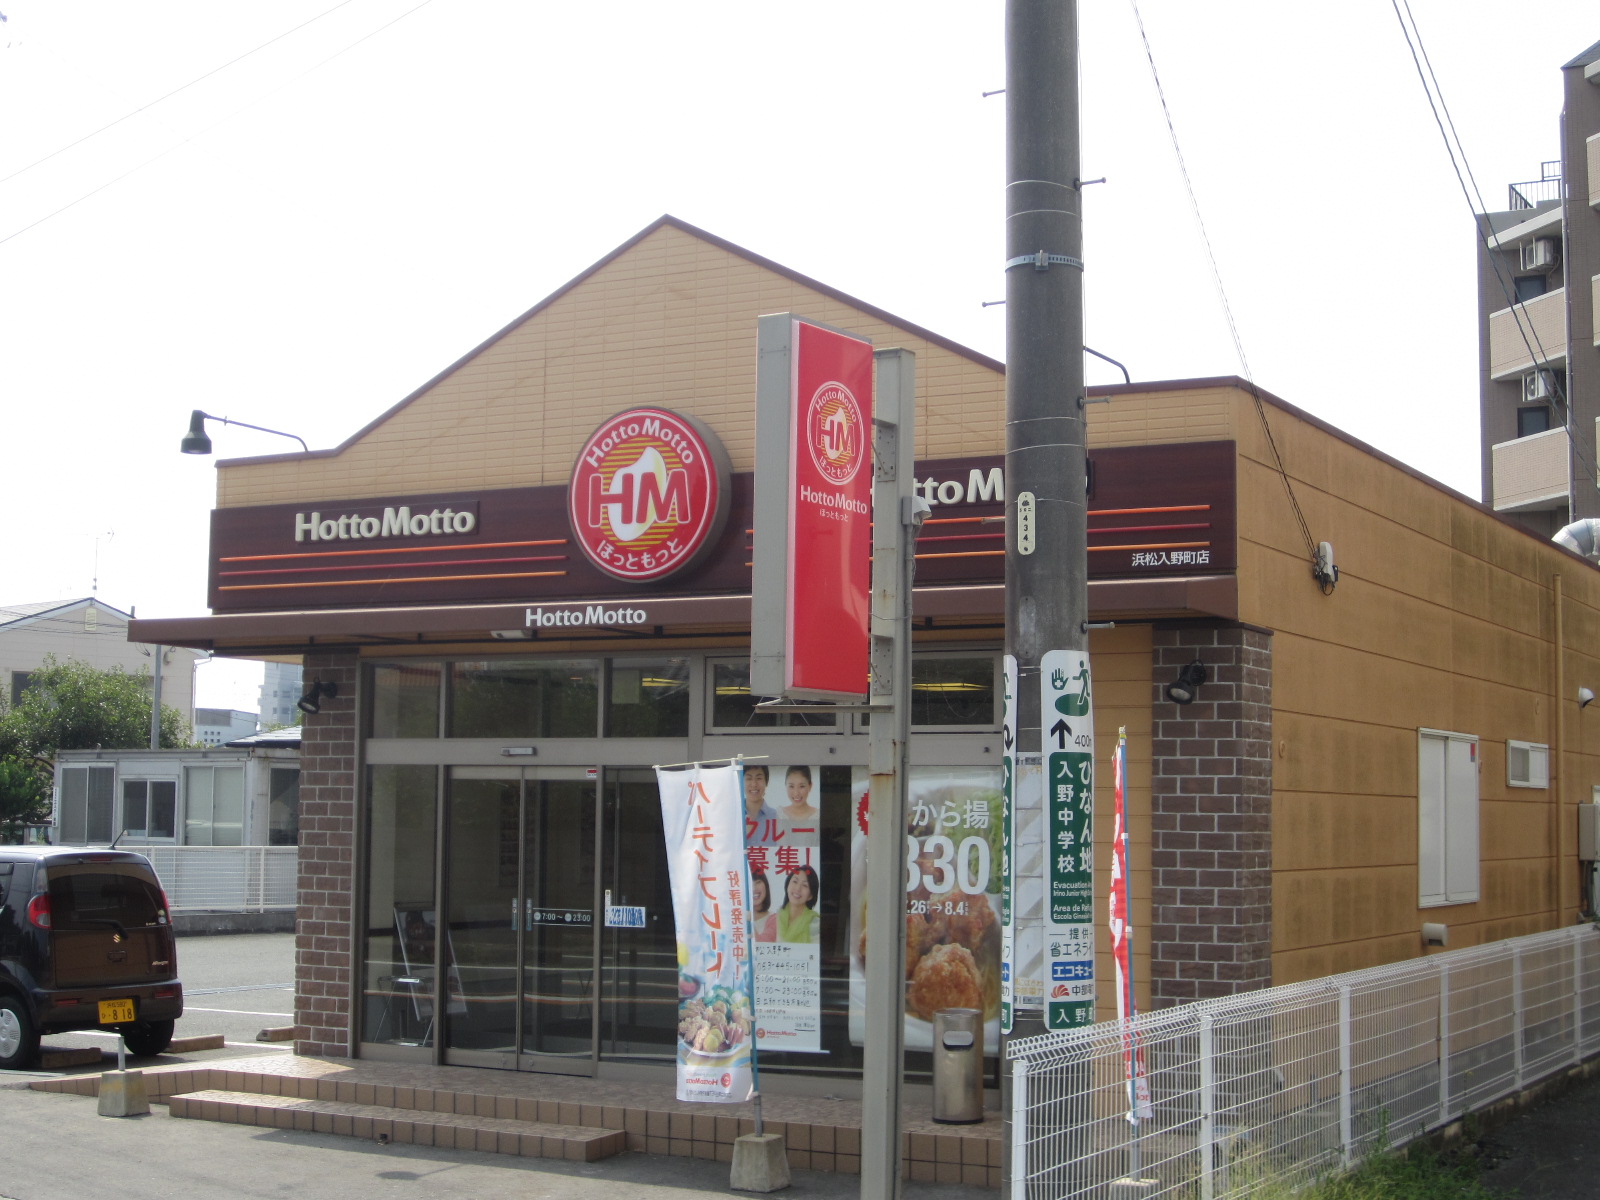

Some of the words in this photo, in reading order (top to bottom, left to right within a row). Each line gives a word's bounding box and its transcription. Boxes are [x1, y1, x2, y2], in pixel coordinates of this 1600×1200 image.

[589, 468, 691, 527] HM
[819, 508, 849, 522] ほっともっと
[596, 537, 683, 570] ほっともっと
[1131, 550, 1210, 567] 浜松入野町店
[911, 799, 990, 829] から揚
[1057, 760, 1075, 873] 入野中学校
[747, 845, 812, 877] 募集！
[944, 901, 964, 916] 8.4
[1069, 927, 1089, 940] 提供
